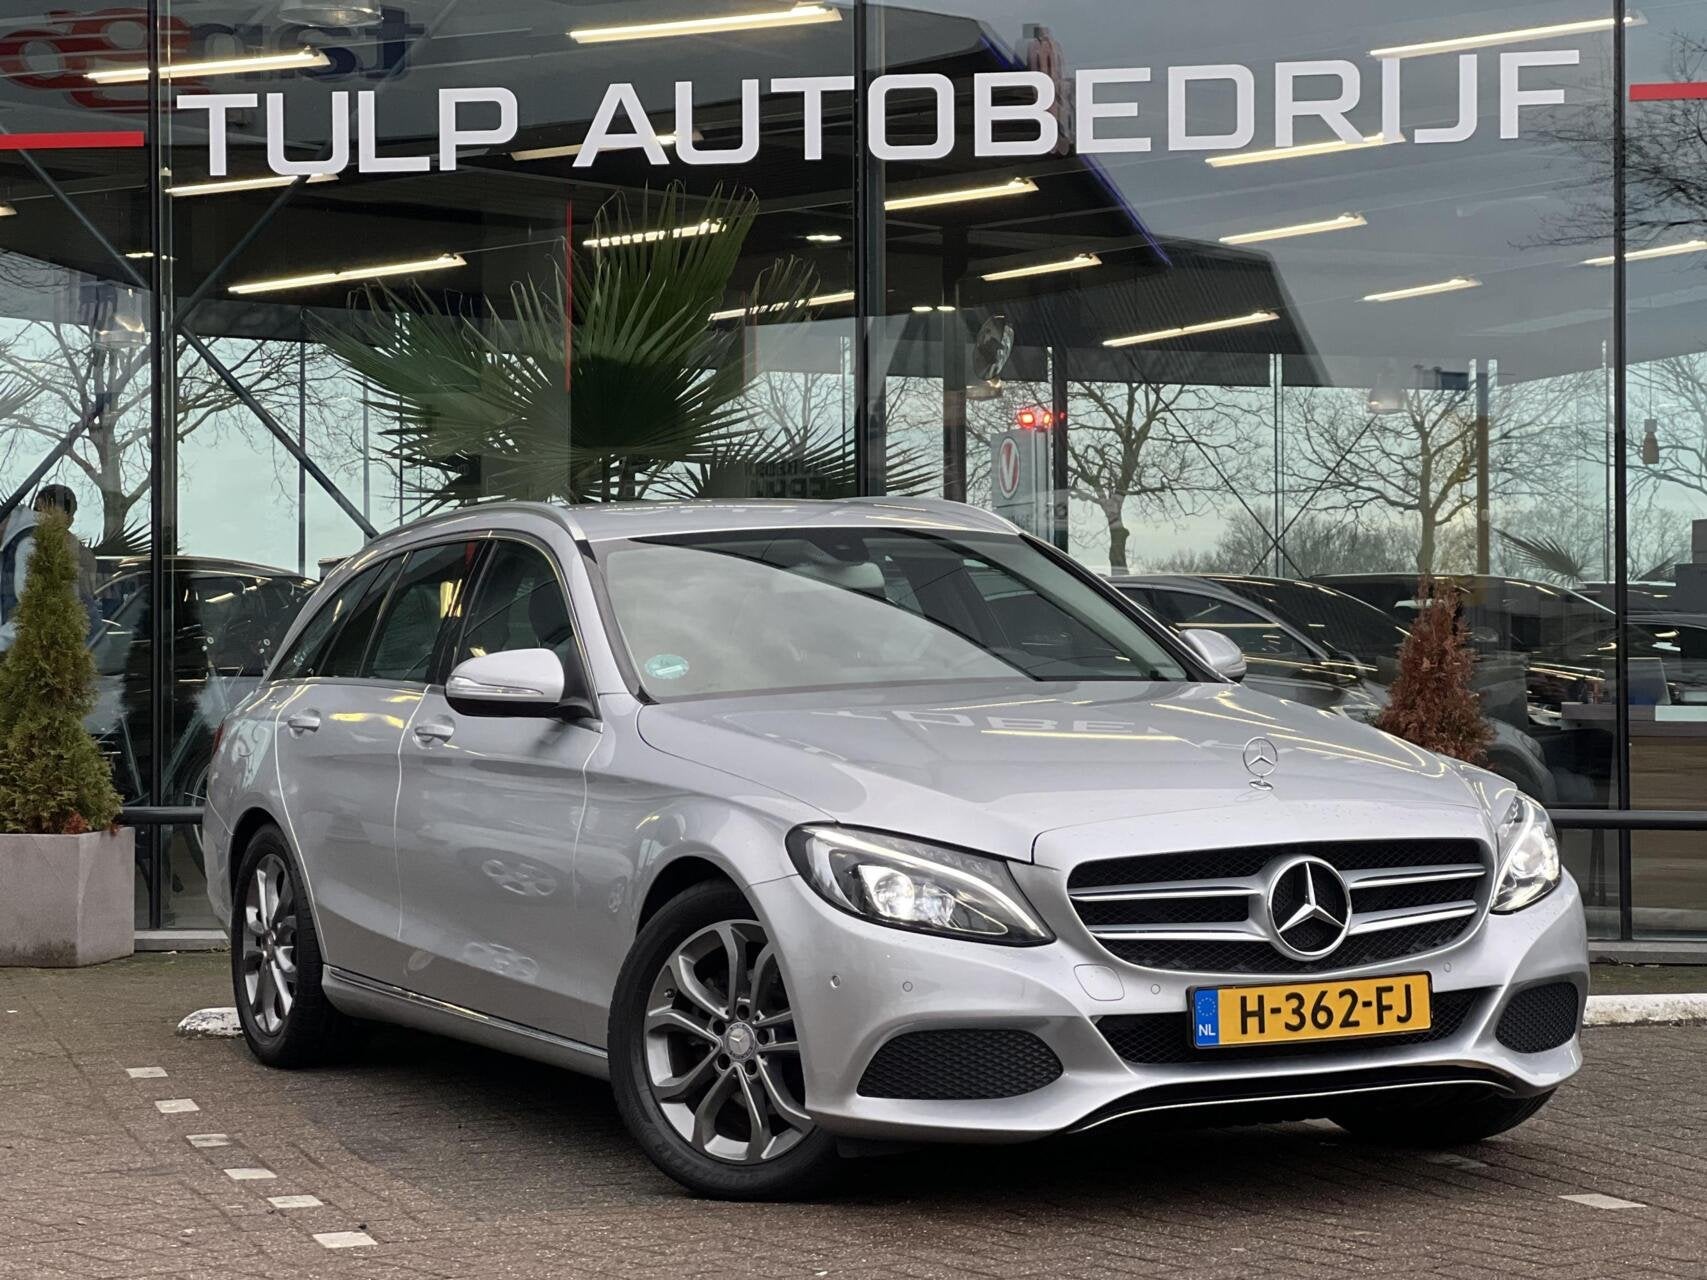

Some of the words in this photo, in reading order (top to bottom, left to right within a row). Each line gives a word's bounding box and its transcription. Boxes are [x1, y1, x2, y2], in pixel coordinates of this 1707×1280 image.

[176, 86, 519, 177] TULP
[573, 49, 1580, 168] AUTOBEDRIJF
[1198, 1023, 1216, 1036] NL
[1239, 983, 1413, 1035] H-362-FJ
